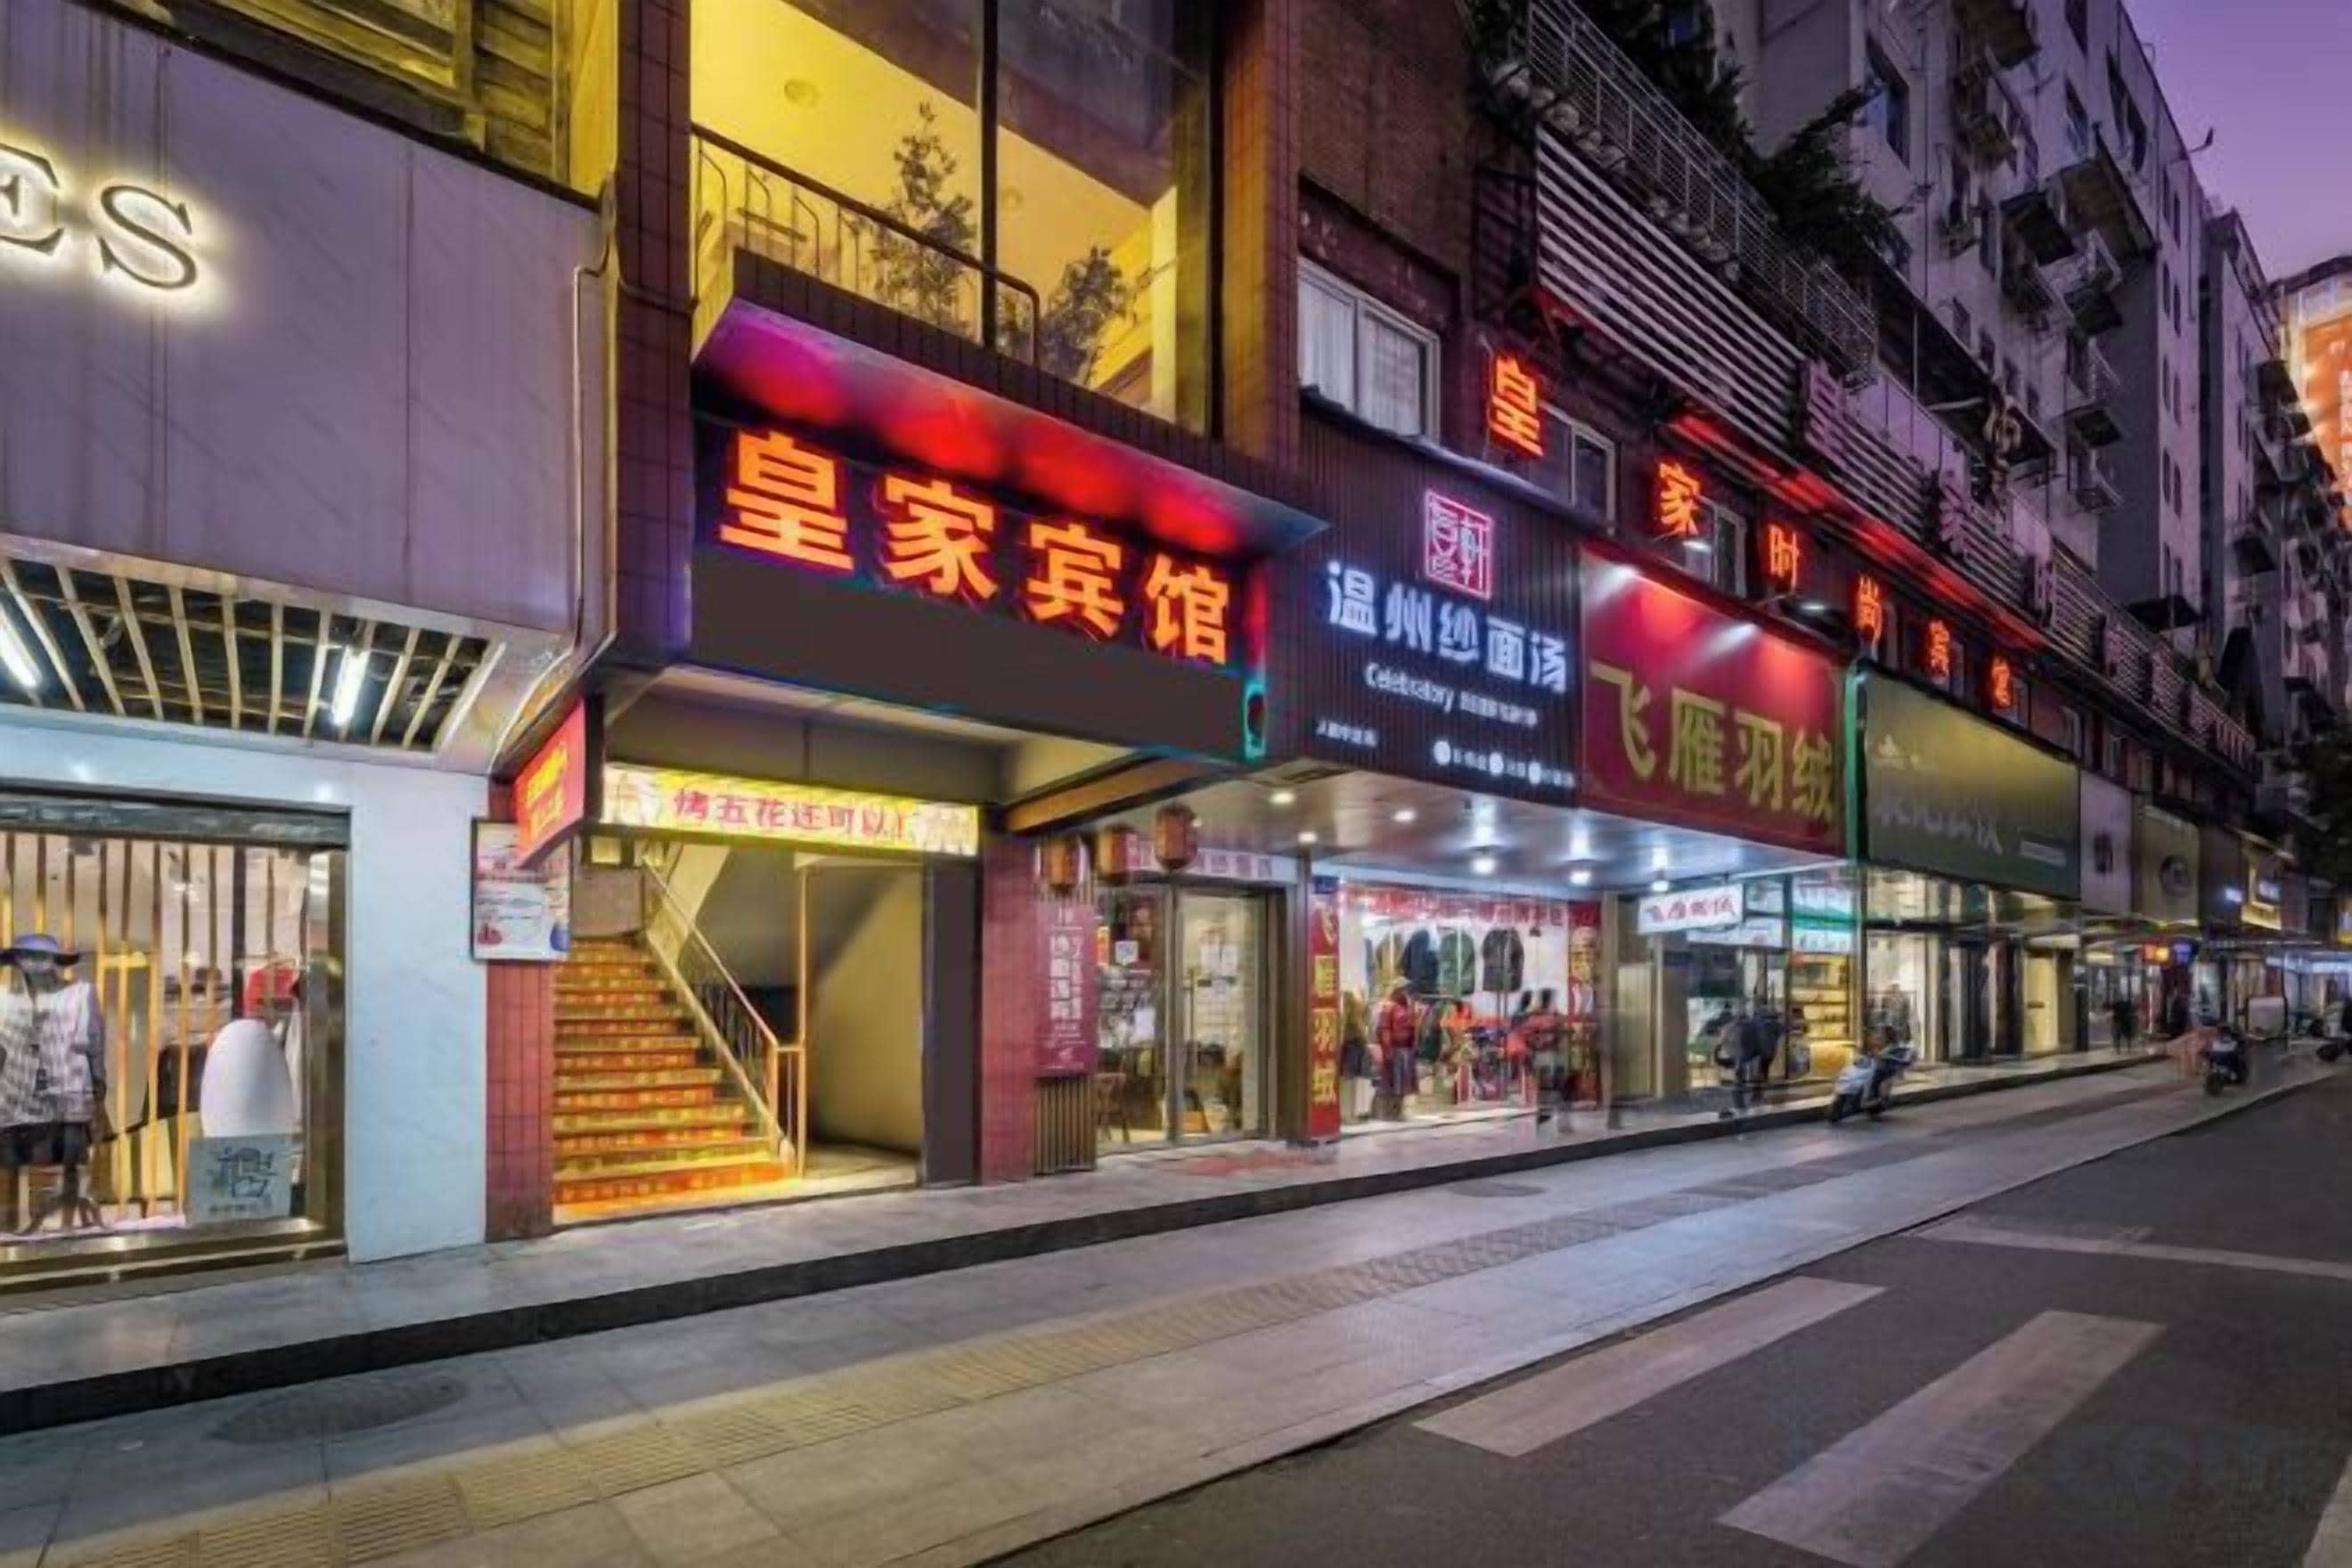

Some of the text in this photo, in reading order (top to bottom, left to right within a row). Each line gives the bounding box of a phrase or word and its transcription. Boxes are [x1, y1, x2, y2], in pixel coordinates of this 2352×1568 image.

[720, 431, 1230, 666] 皇家宾馆
[1588, 659, 1833, 821] 飞雁羽绒
